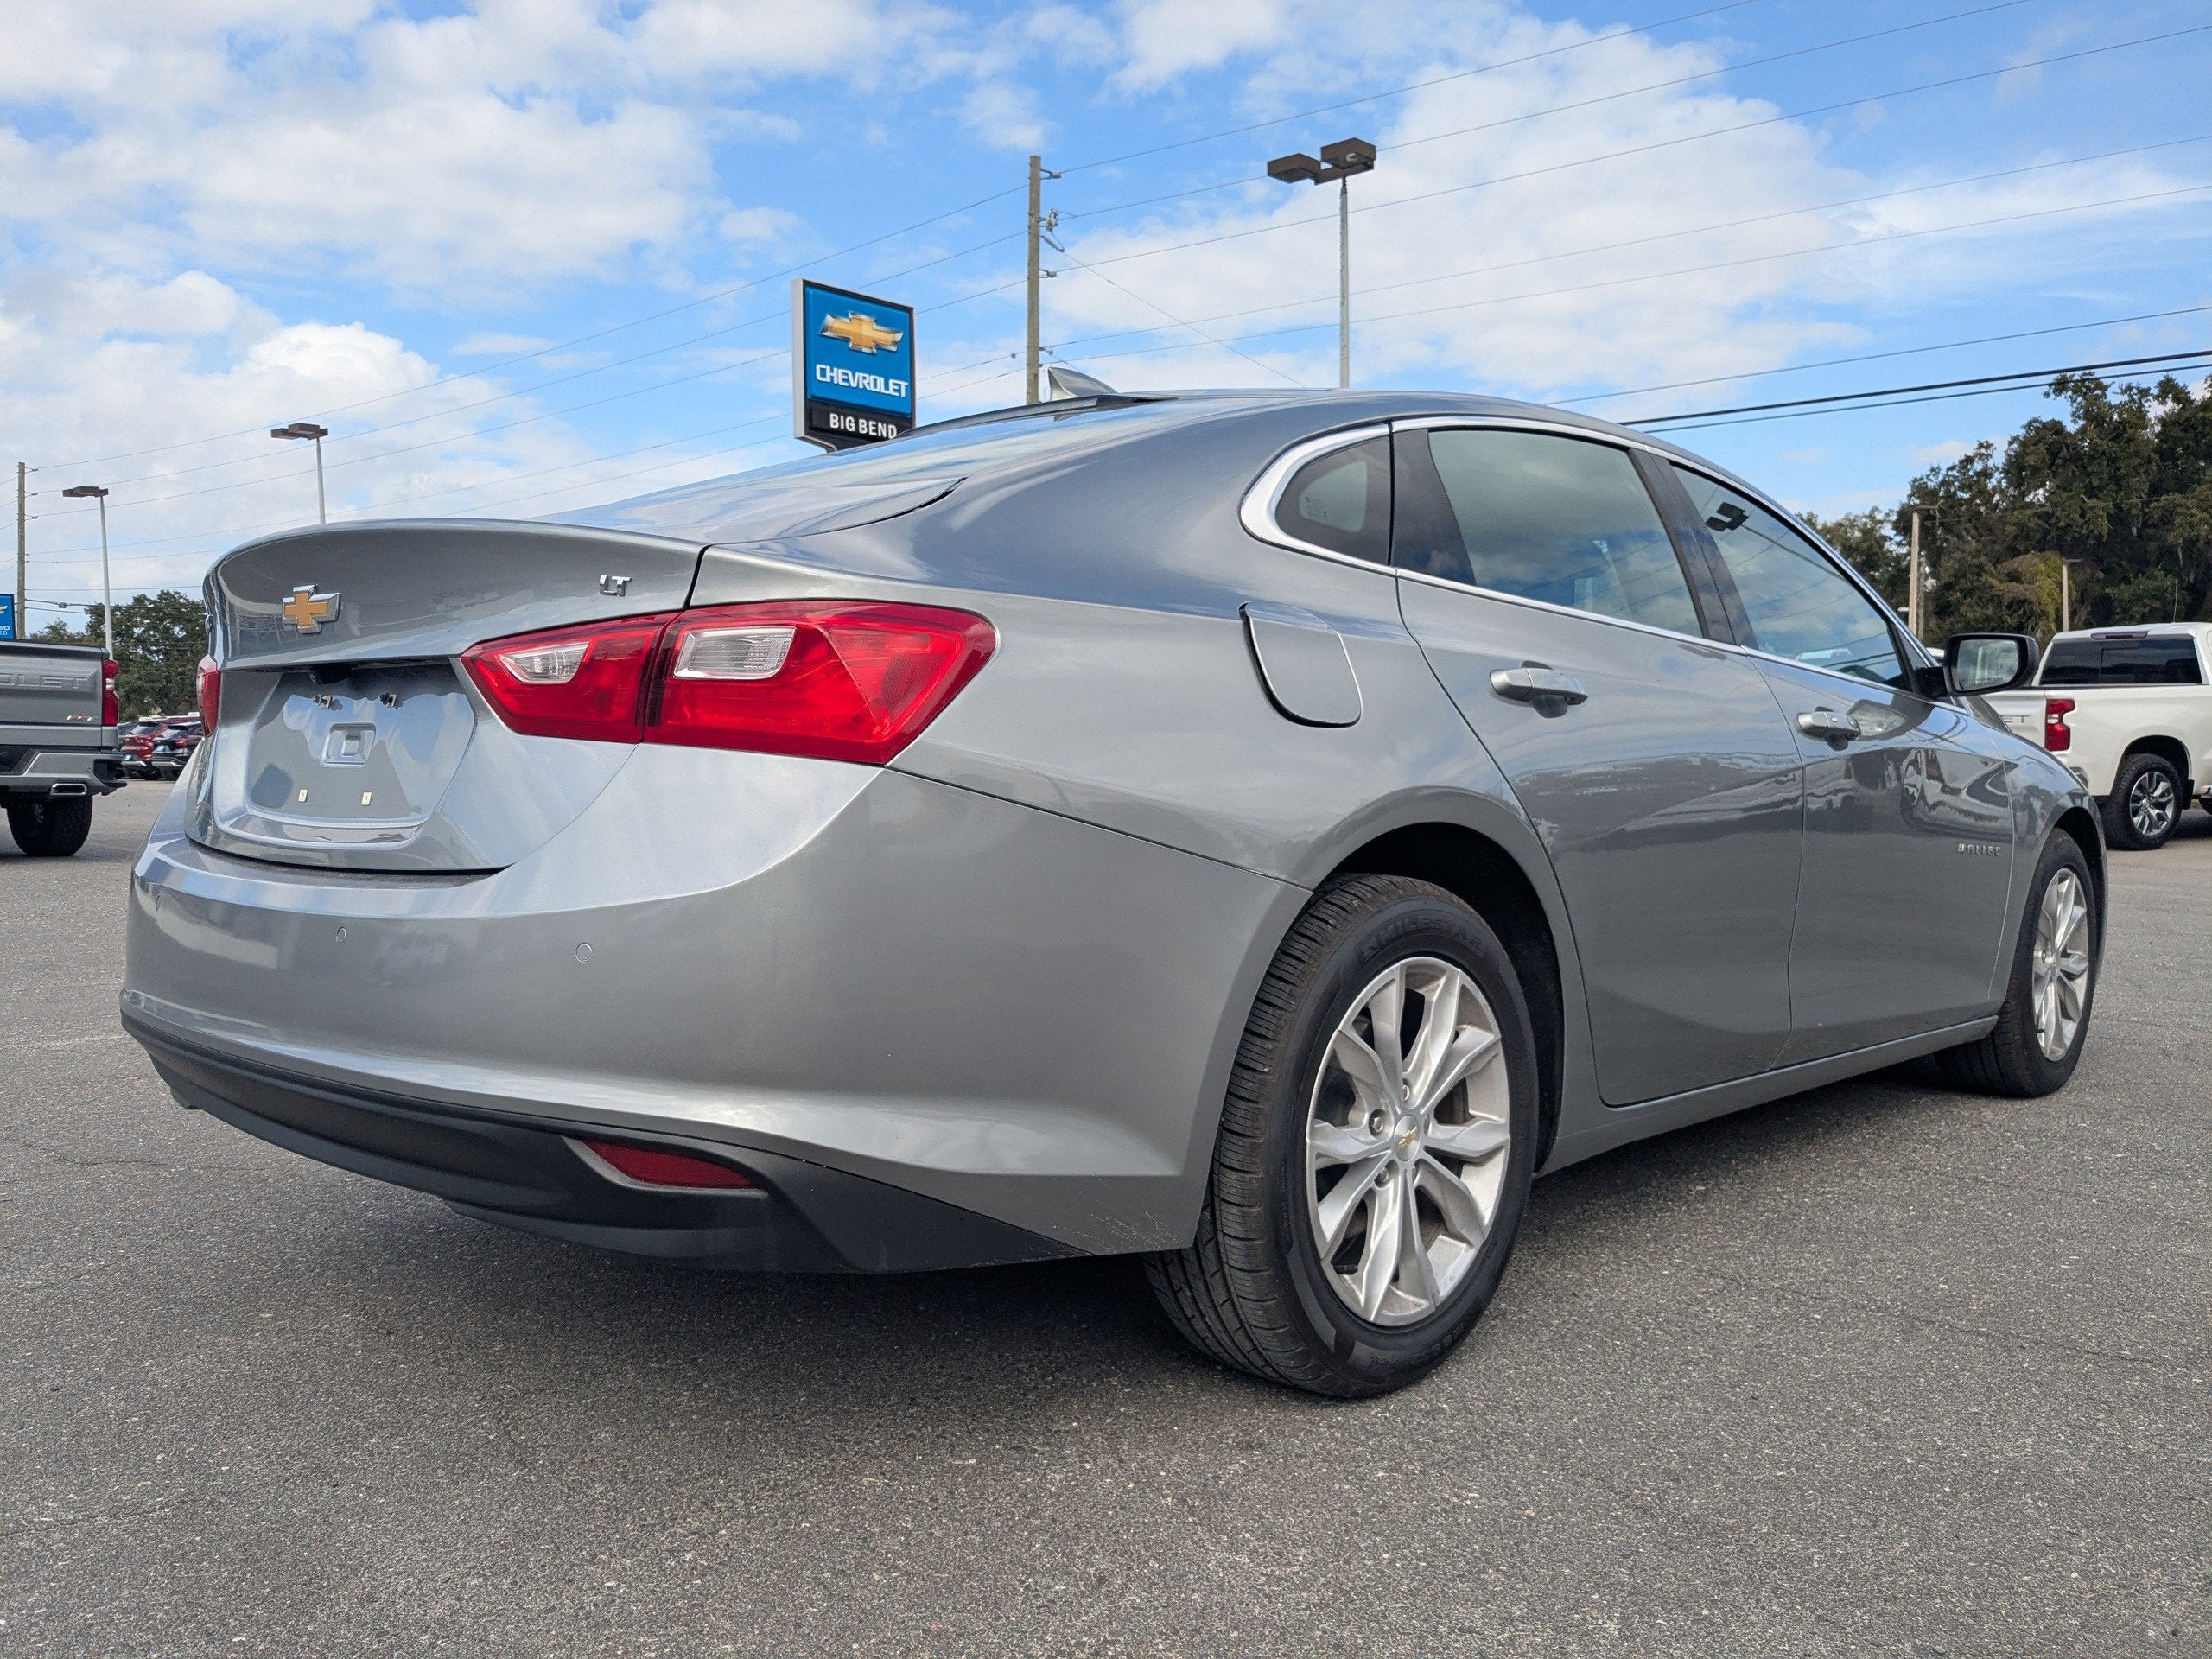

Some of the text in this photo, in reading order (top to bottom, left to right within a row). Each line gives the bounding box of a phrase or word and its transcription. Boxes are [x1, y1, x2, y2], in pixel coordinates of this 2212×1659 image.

[816, 364, 908, 397] CHEVROLET
[830, 413, 897, 440] BIG BEND
[599, 575, 632, 596] LT
